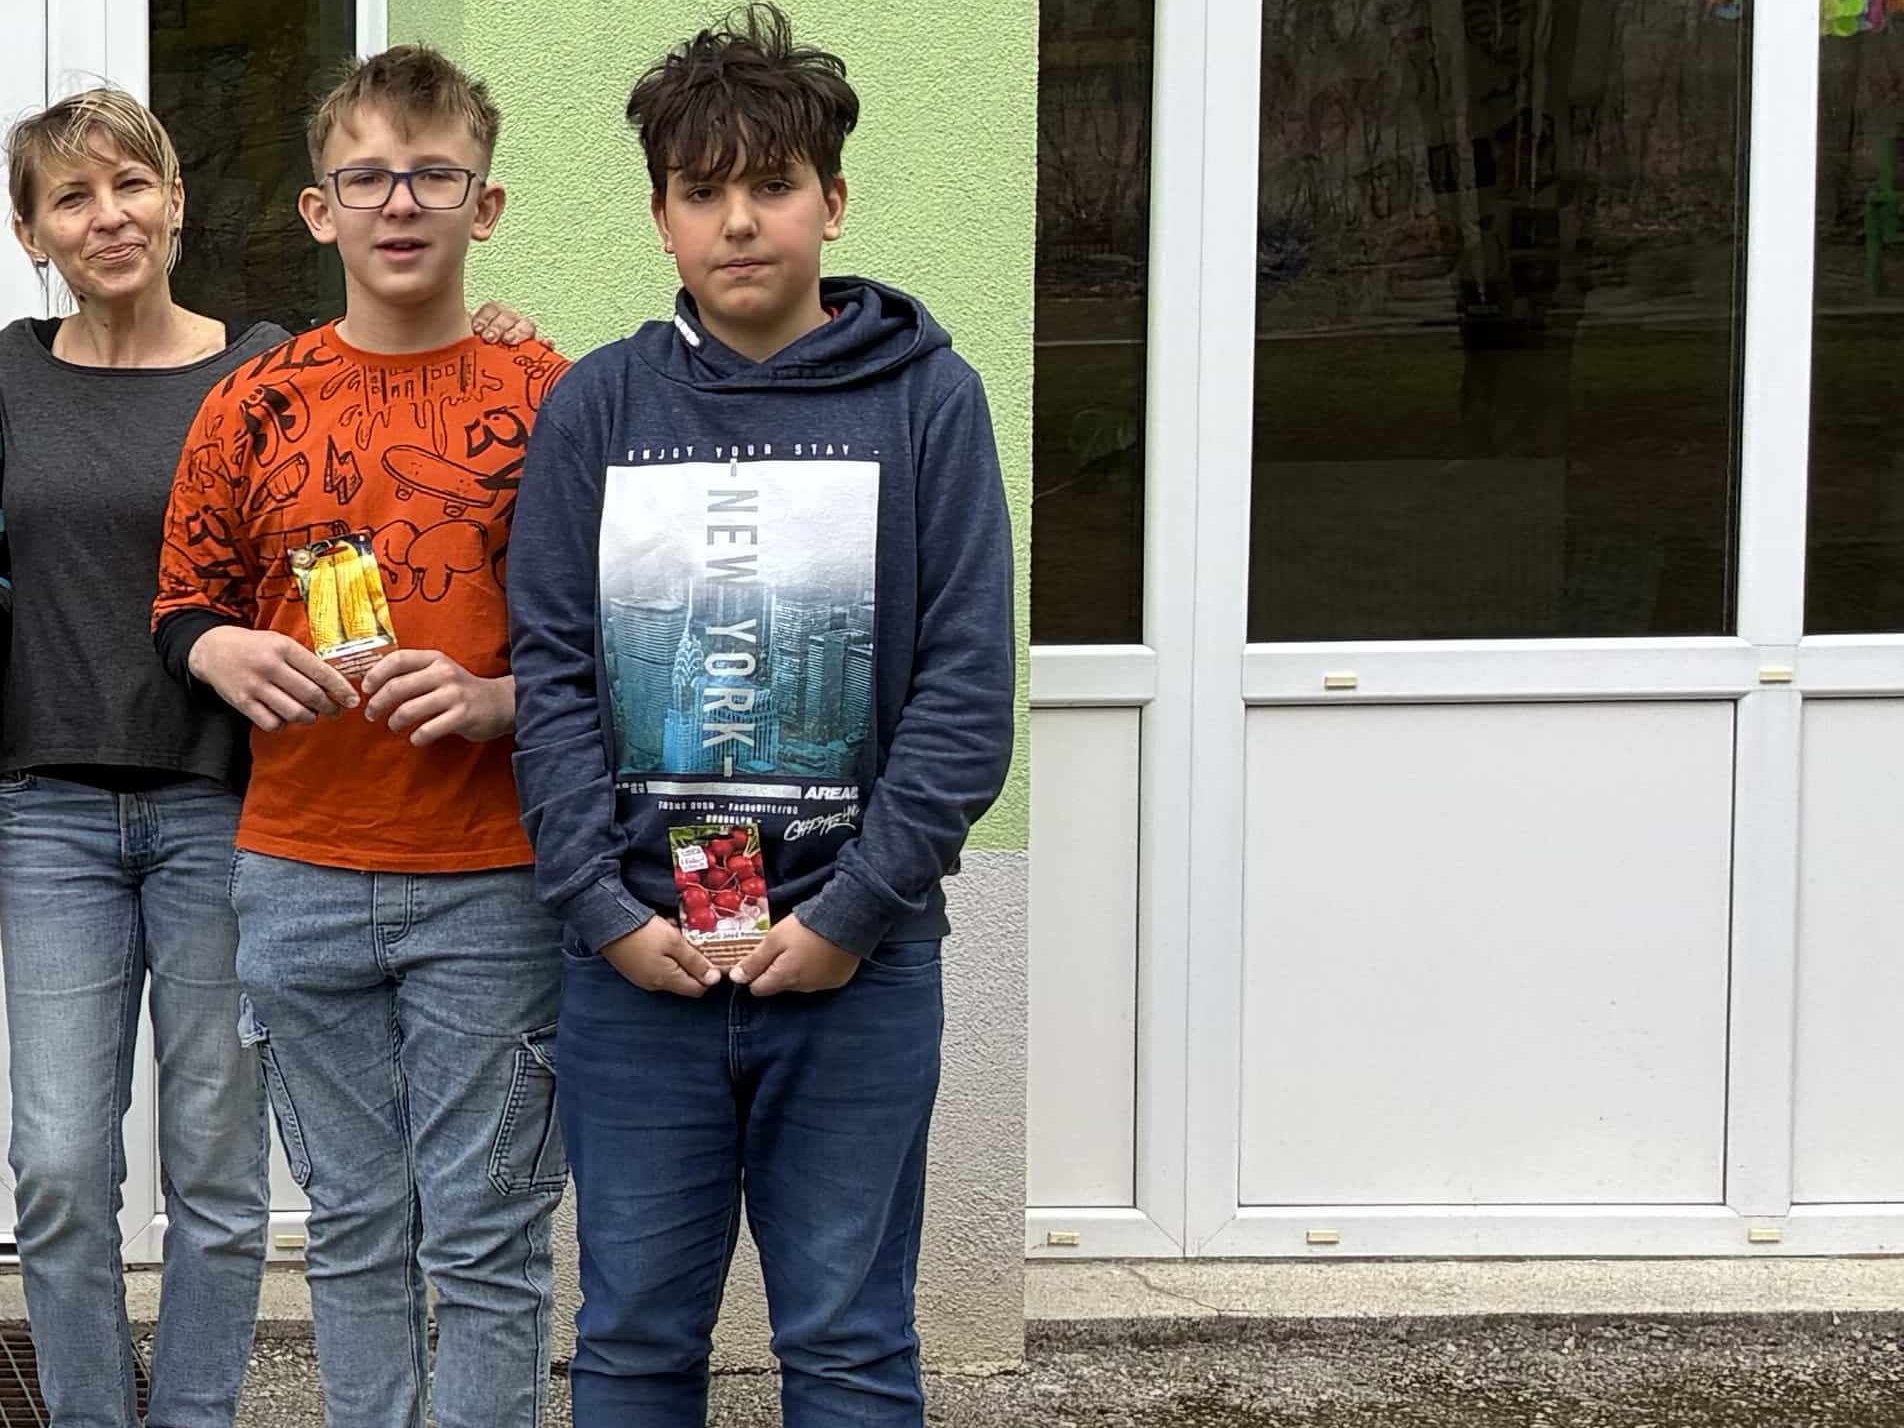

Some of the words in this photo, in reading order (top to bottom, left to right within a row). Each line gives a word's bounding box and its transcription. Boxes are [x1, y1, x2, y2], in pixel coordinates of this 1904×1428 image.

[627, 444, 695, 461] ENJOY
[715, 443, 773, 459] YOUR
[794, 443, 851, 456] STAY
[705, 488, 760, 584] NEW
[702, 617, 758, 749] YORK
